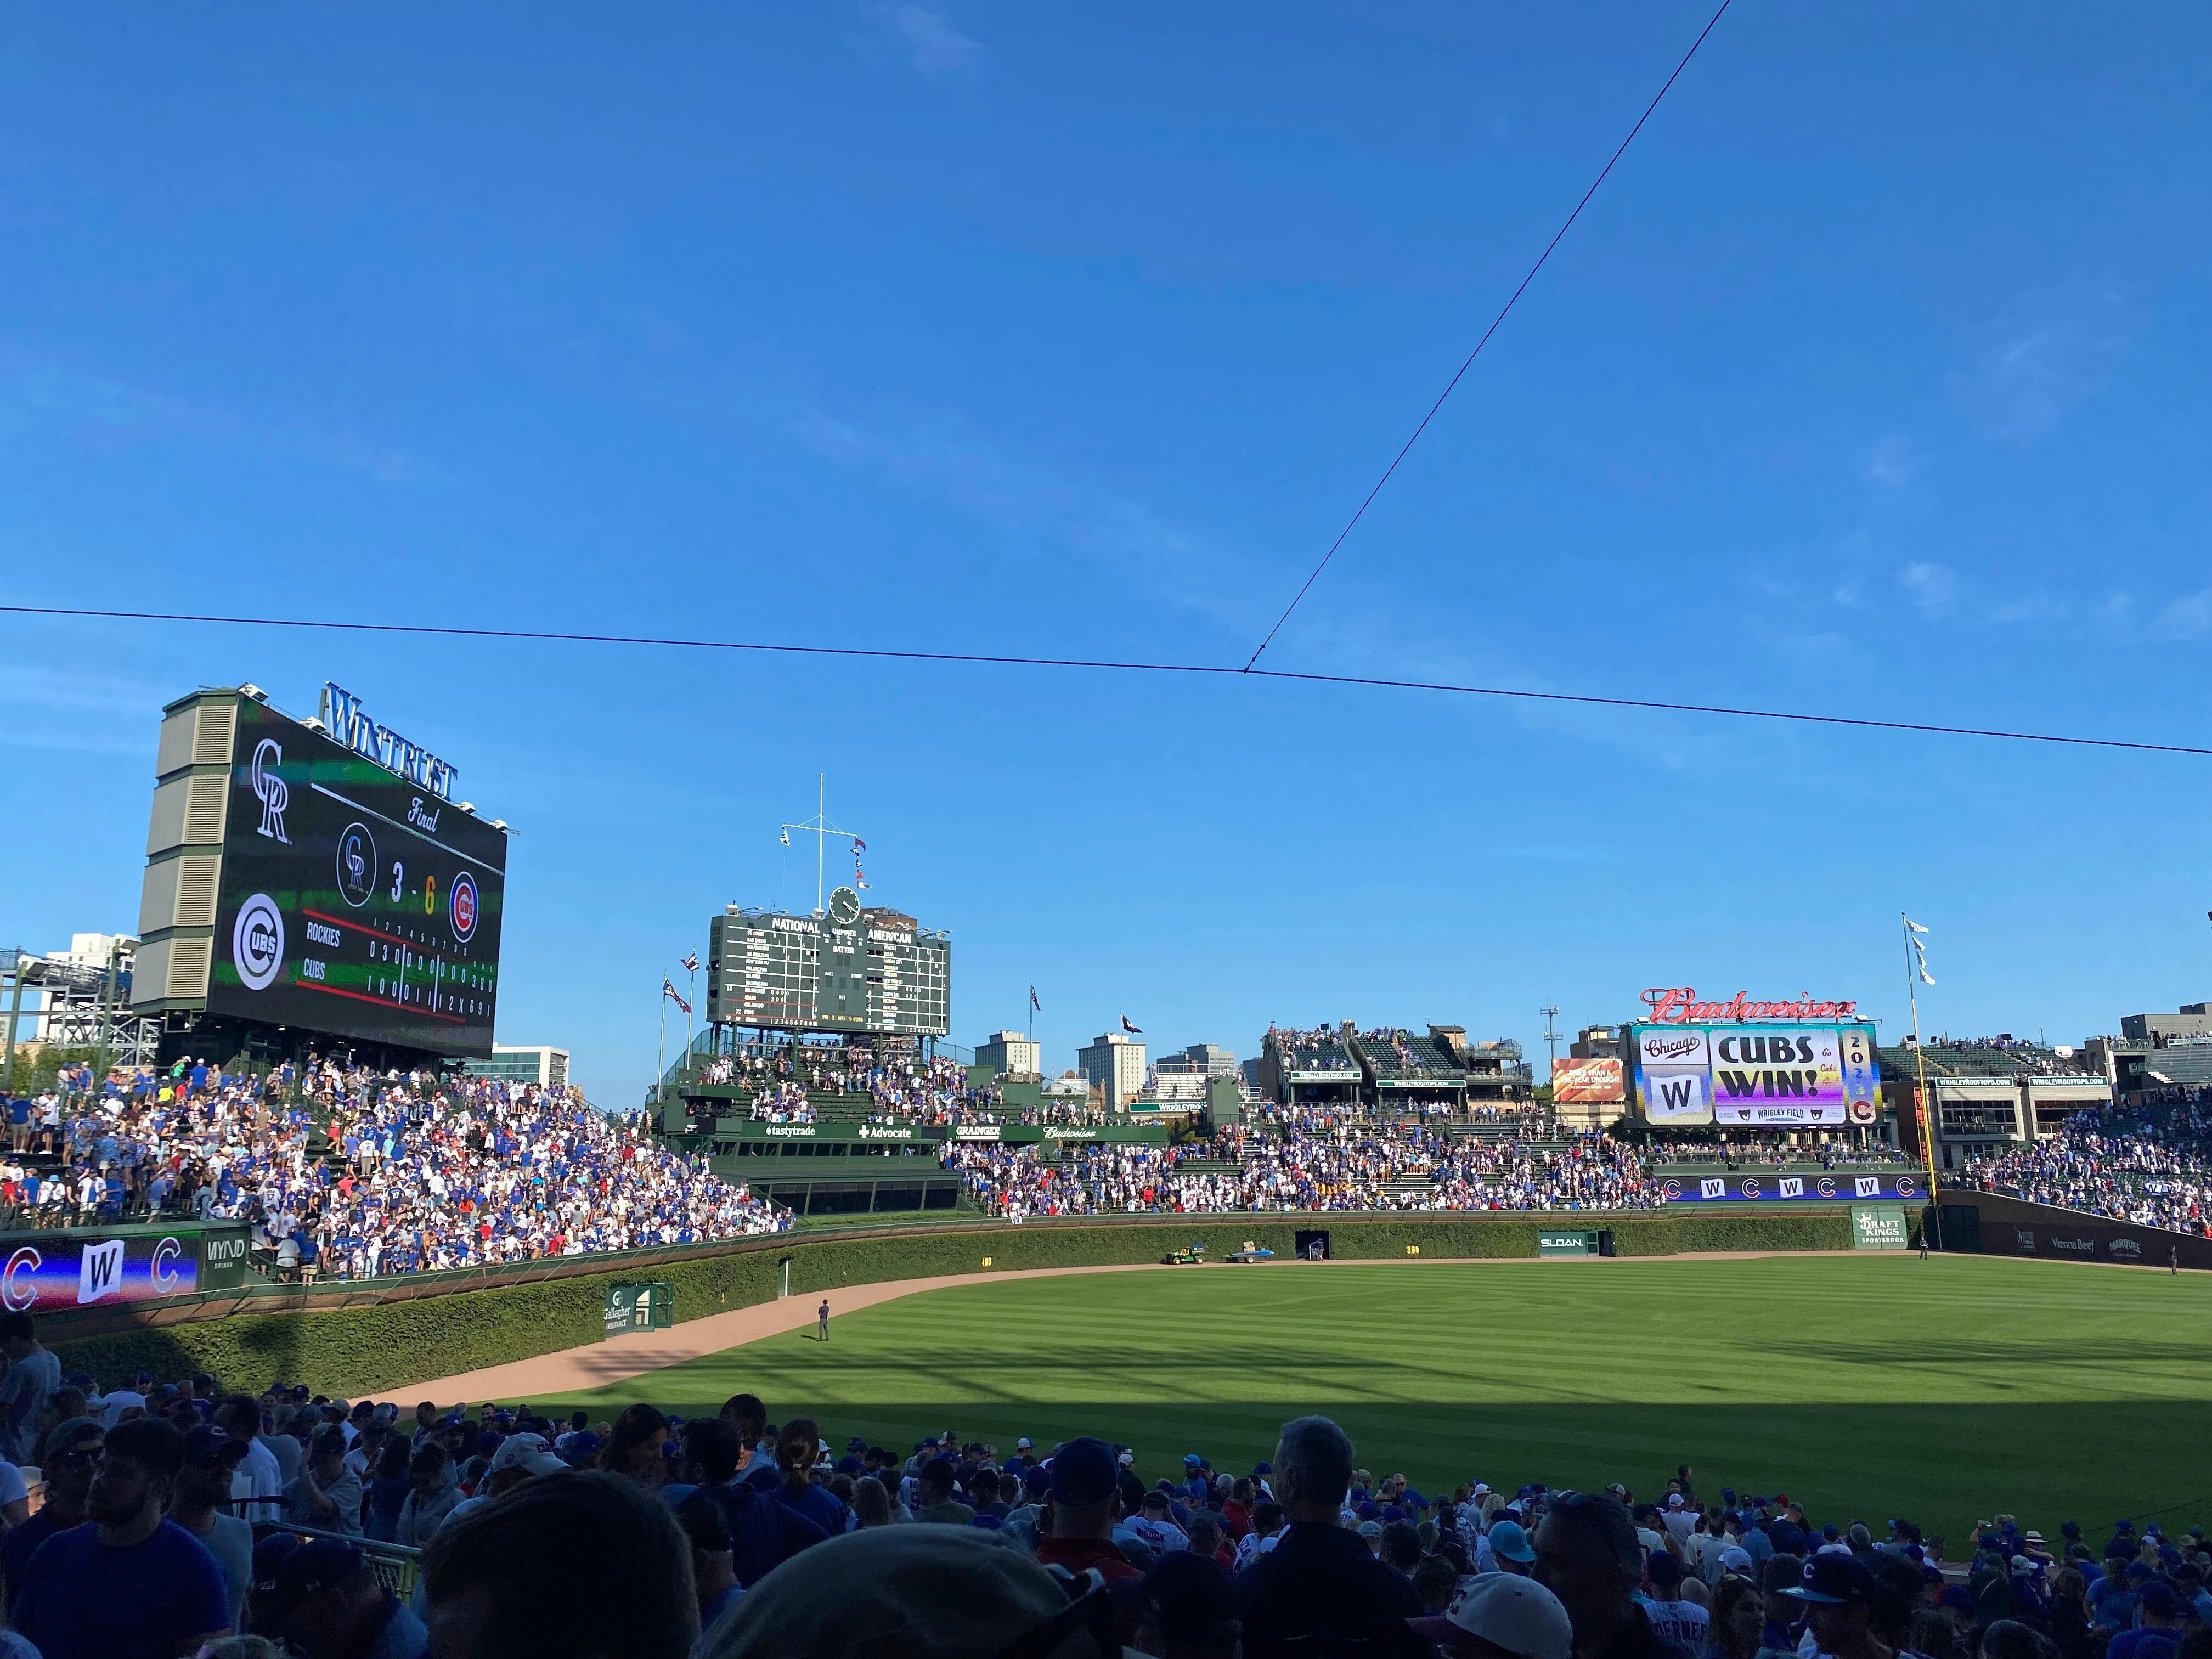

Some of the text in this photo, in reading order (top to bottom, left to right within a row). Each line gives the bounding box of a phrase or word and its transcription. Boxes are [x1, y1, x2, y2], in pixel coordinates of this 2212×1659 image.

[325, 681, 458, 801] WINTRUST
[408, 797, 440, 833] Final
[391, 862, 403, 902] 3
[425, 875, 436, 915] 6
[772, 917, 821, 934] NATIONAL
[832, 928, 857, 937] UMPIRES
[867, 929, 911, 944] AMERICAN
[307, 922, 340, 948] ROCKIES
[369, 940, 376, 958] 0
[382, 944, 388, 961] 3
[394, 948, 400, 964] 0
[406, 952, 412, 968] 0
[417, 955, 423, 971] 0
[430, 958, 435, 974] 0
[440, 962, 445, 977] 0
[451, 965, 456, 980] 0
[461, 968, 466, 983] 0
[472, 975, 476, 988] 3
[480, 977, 484, 990] 8
[488, 979, 493, 992] 0
[303, 958, 490, 1017] CUBS 1 0 0 0 1 1 1 2 X 6 9 1
[1640, 988, 1857, 1023] Budweiser
[1644, 1036, 1701, 1058] Chicago
[1718, 1036, 1812, 1064] CUBS
[1822, 1048, 1831, 1057] Go
[1718, 1070, 1819, 1097] WIN!
[2032, 1077, 2103, 1086] WRIGLEYROOFTOPS.COM
[1661, 1080, 1692, 1110] W
[1757, 1109, 1804, 1119] WRIGLEY FIELD
[772, 1126, 816, 1138] tastytrade
[870, 1127, 911, 1138] Advocate
[956, 1126, 1001, 1135] GRAINGER
[1043, 1126, 1097, 1139] Budweiser
[1706, 1181, 1719, 1195] W
[1784, 1181, 1799, 1194] W
[1859, 1180, 1875, 1193] W
[1860, 1220, 1900, 1231] DRAFT
[1865, 1228, 1900, 1237] KINGS
[1541, 1238, 1582, 1248] SLOAN
[2051, 1237, 2077, 1250] Vienna
[2109, 1238, 2142, 1254] MARQUEE
[2, 1237, 182, 1312] C W C
[603, 1305, 631, 1321] Gallagher
[606, 1319, 627, 1330] INSURANCE
